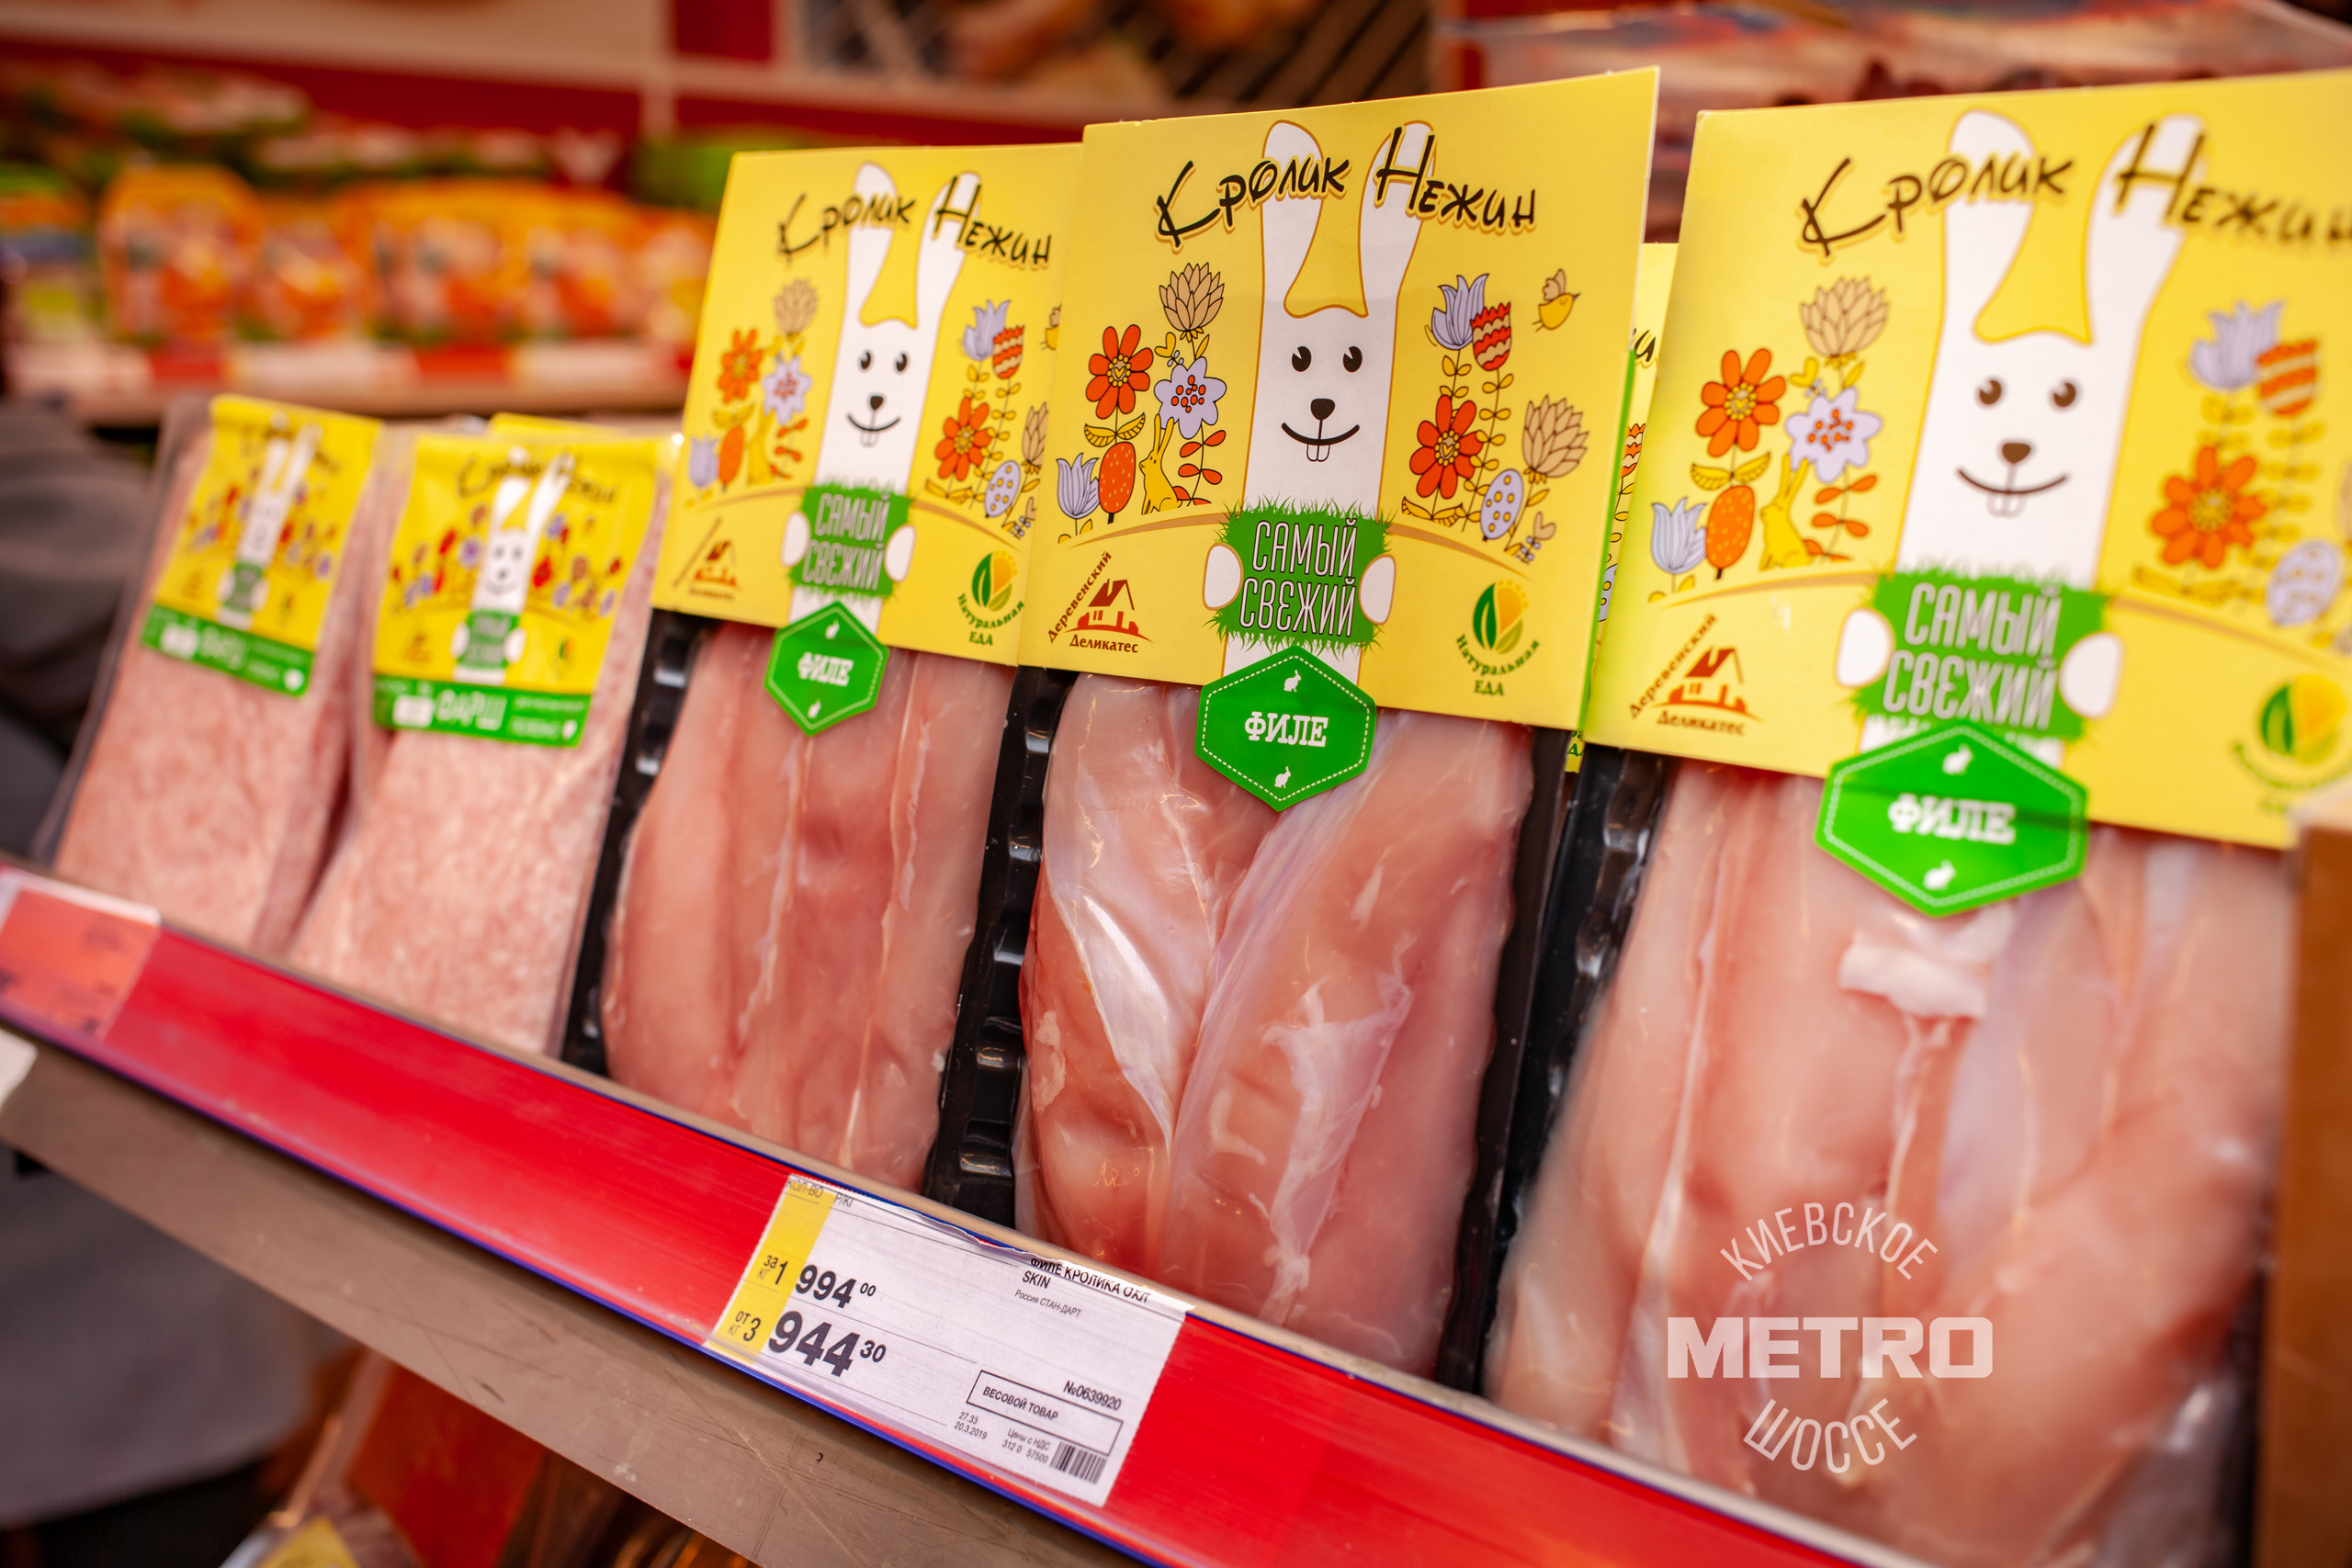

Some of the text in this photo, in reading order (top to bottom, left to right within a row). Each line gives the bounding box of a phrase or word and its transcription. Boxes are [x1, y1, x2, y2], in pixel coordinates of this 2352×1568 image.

[815, 492, 891, 542] САМЫЙ
[801, 539, 885, 592] СВЕЖИЙ
[1251, 517, 1358, 578] САМЫЙ
[957, 592, 1025, 630] Натуральная
[1047, 551, 1113, 643] Деревенский
[1239, 577, 1357, 637] СВЕЖИЙ
[1904, 582, 2063, 657] САМЫЙ
[969, 631, 993, 647] ЕДА
[1069, 634, 1138, 653] Деликатес
[1456, 633, 1540, 677] Натуральная
[797, 651, 854, 687] ФИЛЕ
[1475, 680, 1505, 696] ЕДА
[1882, 649, 2057, 731] СВЕЖИЙ
[1244, 711, 1329, 749] ФИЛЕ
[1887, 793, 2017, 846] ФИЛЕ
[775, 1260, 788, 1285] 1
[796, 1264, 877, 1309] 994 00
[1022, 1270, 1051, 1289] SKIN
[1030, 1258, 1062, 1276] ФИЛЕ
[1064, 1266, 1120, 1294] КРОЛИКА
[1014, 1289, 1082, 1317] Россия СТАН-ДАРТ
[742, 1317, 762, 1341] 3
[768, 1310, 887, 1377] 944 30
[982, 1386, 1059, 1420] ВЕСОВОЙ ТОВАР
[1063, 1380, 1122, 1411] №0639920
[954, 1421, 988, 1439] 20.3.2019
[1001, 1439, 1017, 1452] 312
[1007, 1427, 1027, 1443] Цены
[1033, 1438, 1051, 1451] НДС
